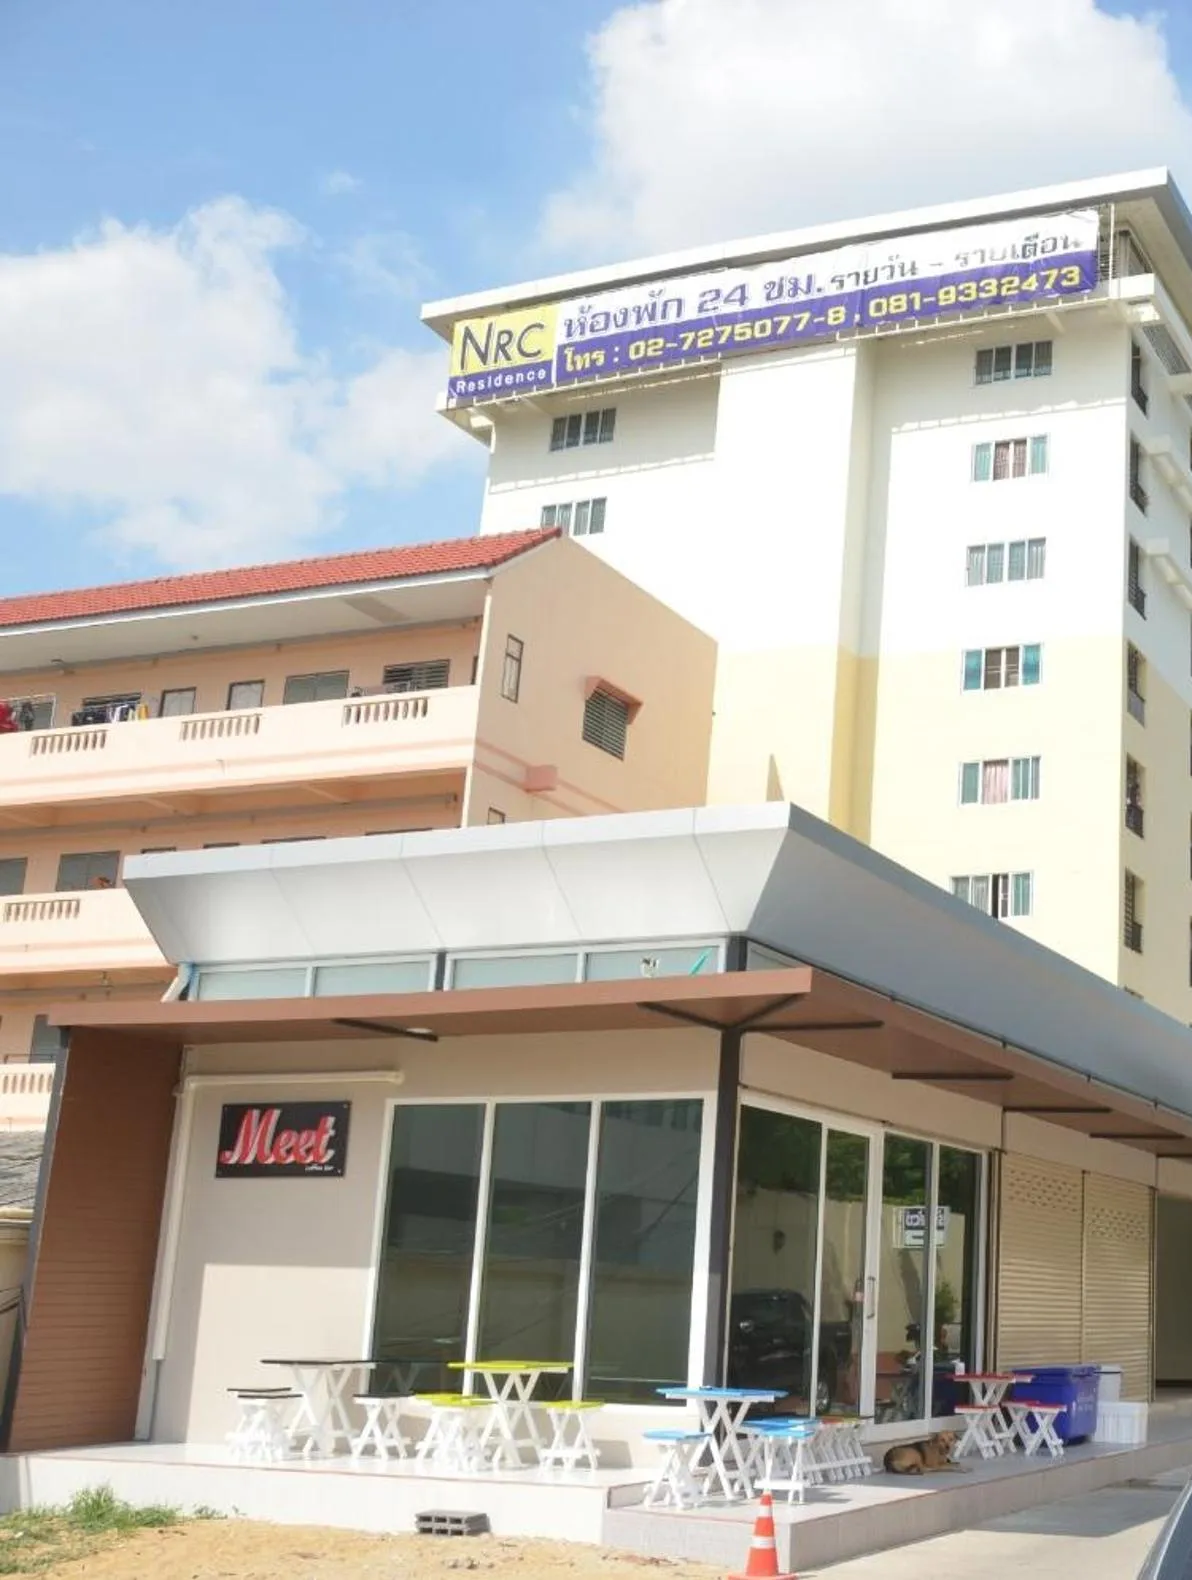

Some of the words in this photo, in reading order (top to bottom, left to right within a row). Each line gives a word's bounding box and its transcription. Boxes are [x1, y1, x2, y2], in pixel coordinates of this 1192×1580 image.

[564, 289, 686, 338] ห้องพัก
[698, 283, 750, 313] 24
[868, 265, 1081, 318] 081-9332473
[460, 321, 545, 370] NRC
[456, 368, 546, 395] Residence
[219, 1107, 337, 1165] Meet
